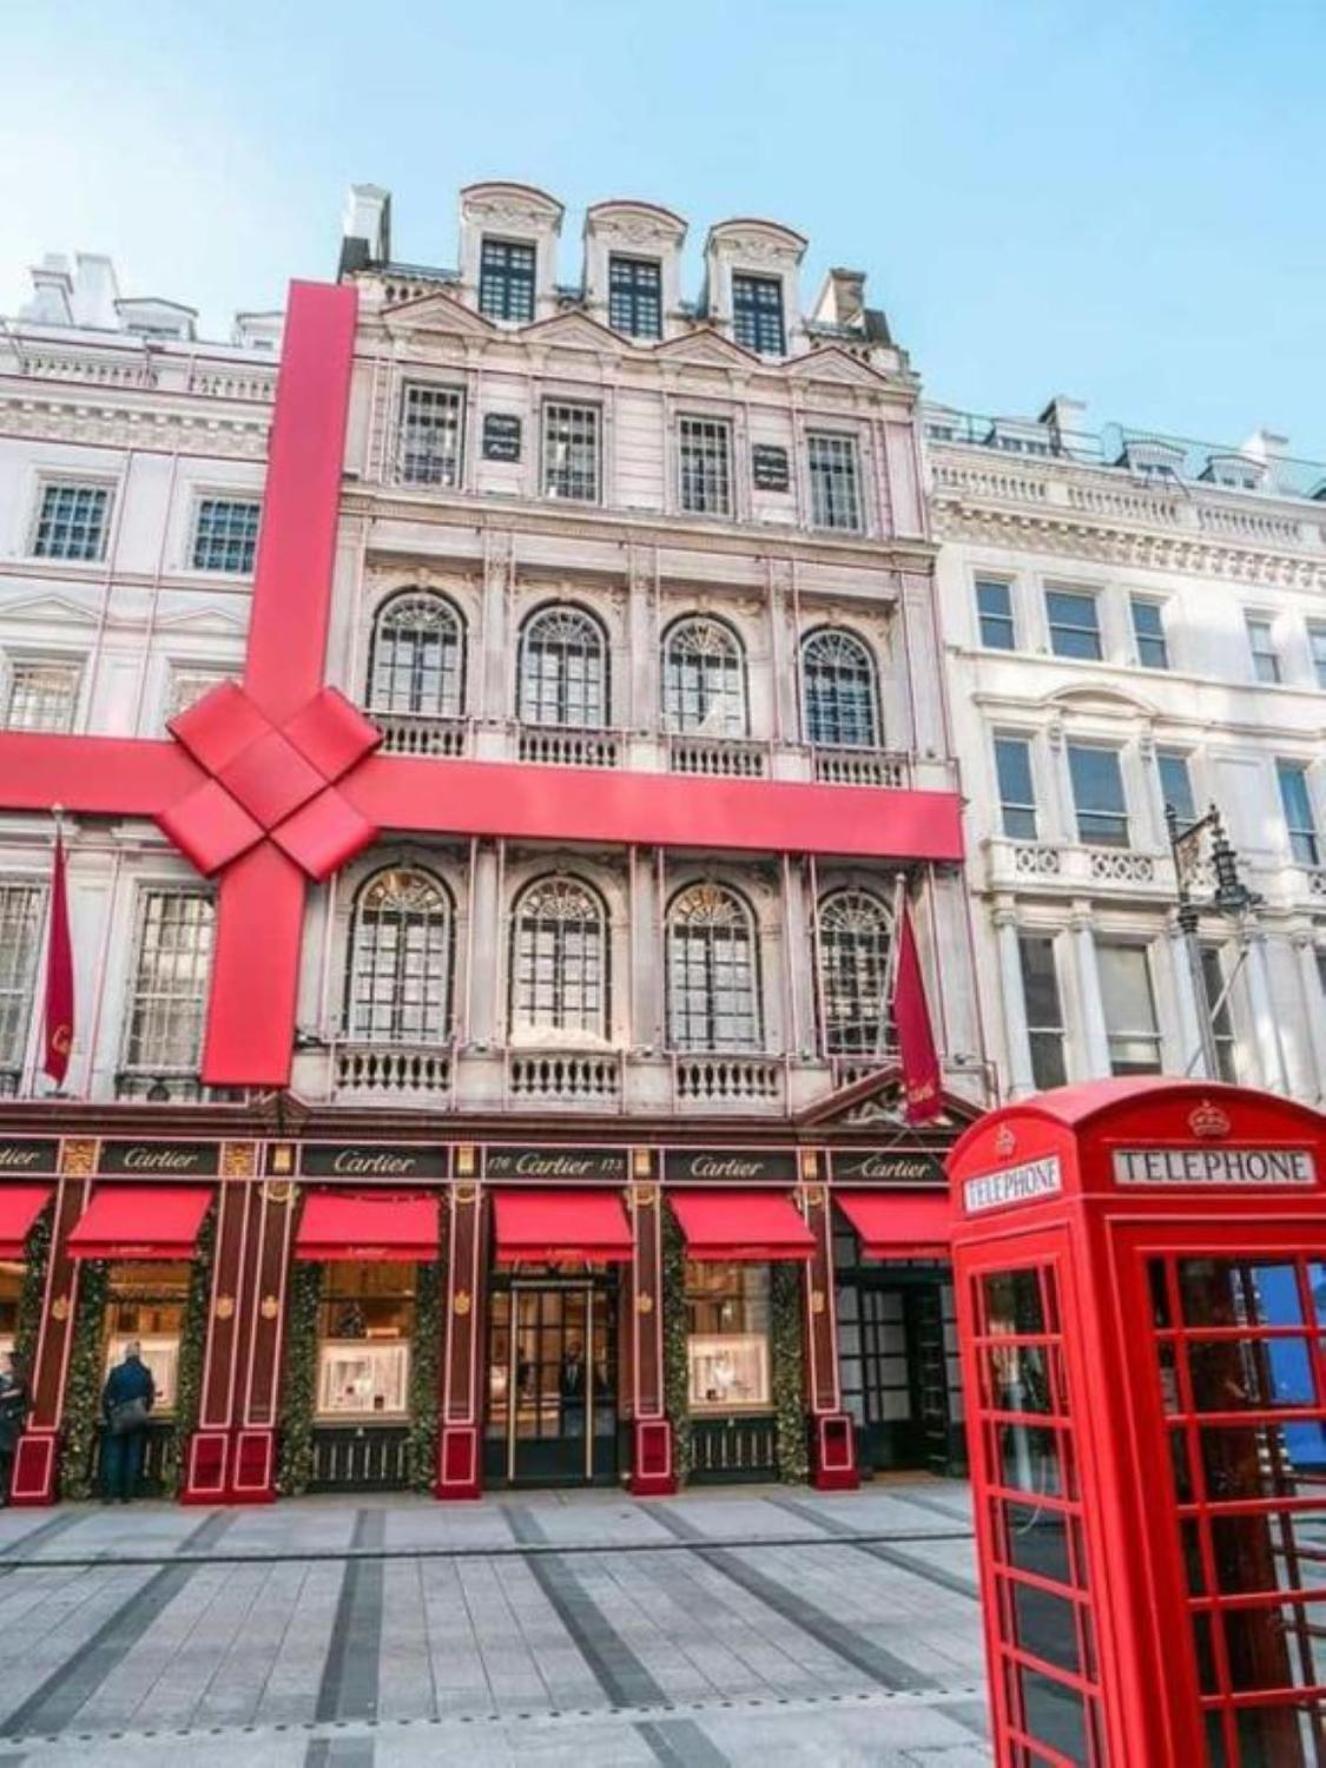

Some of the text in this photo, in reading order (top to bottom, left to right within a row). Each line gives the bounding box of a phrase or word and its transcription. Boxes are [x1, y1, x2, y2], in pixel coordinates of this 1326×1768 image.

[0, 1148, 41, 1165] tier
[123, 1147, 198, 1168] Cartier
[334, 1149, 416, 1173] Cartier
[516, 1152, 594, 1175] Cartier
[689, 1155, 764, 1178] Cartier
[861, 1155, 931, 1178] Cartier
[1119, 1151, 1309, 1182] TELEPHONE
[968, 1159, 1057, 1207] TELEPHONE
